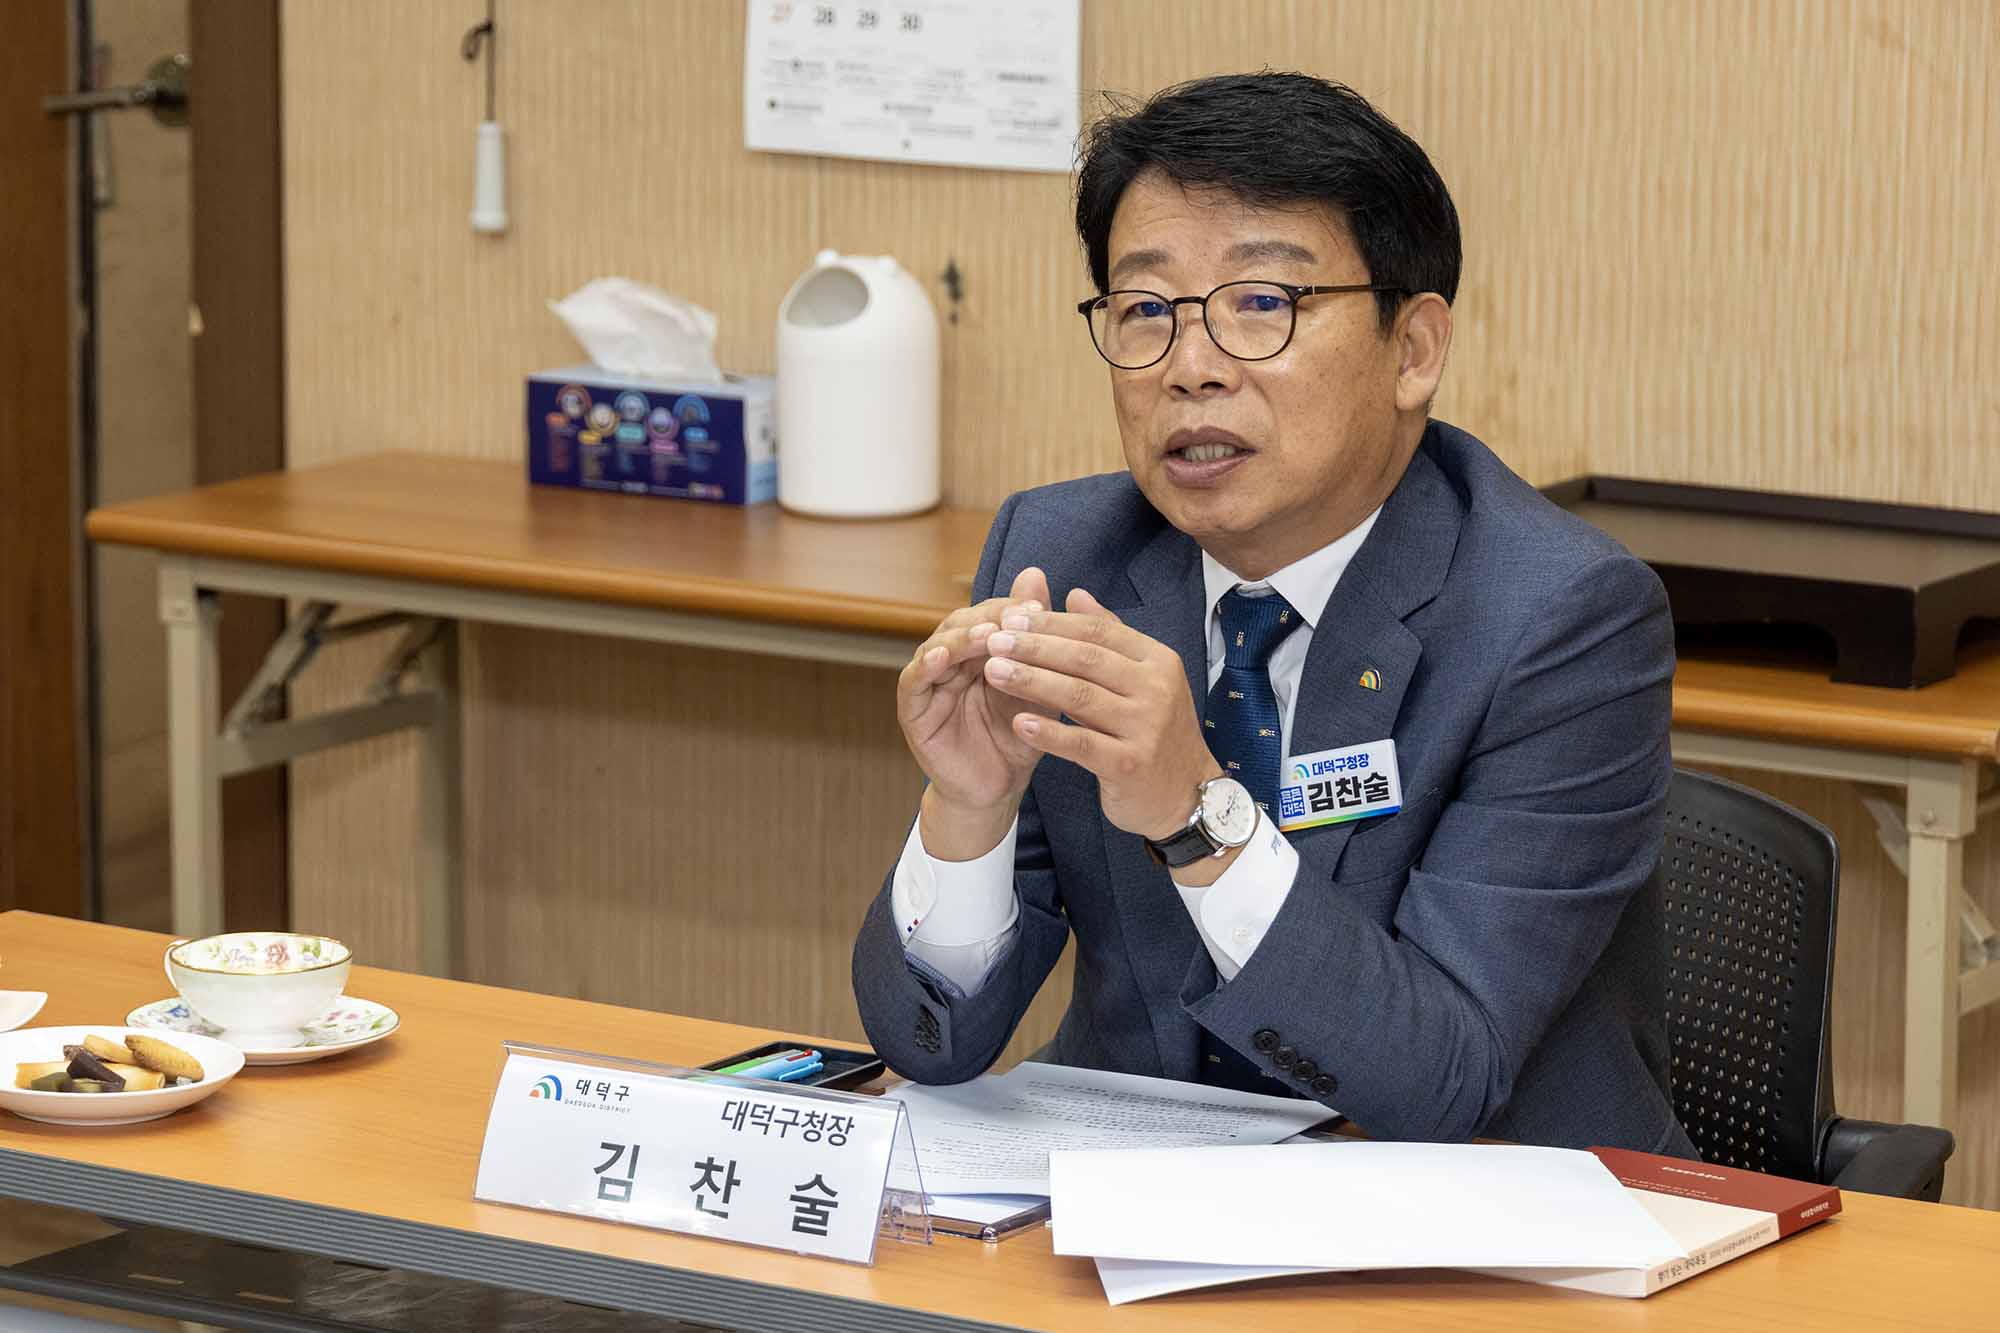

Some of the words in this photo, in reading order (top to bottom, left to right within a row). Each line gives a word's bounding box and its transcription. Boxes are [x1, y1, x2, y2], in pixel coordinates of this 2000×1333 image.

[1311, 753, 1369, 776] 대덕구청장
[1307, 771, 1390, 813] 김찬술
[1282, 801, 1305, 818] 대덕
[576, 1079, 630, 1102] 대덕구
[721, 1100, 855, 1146] 대덕구청장
